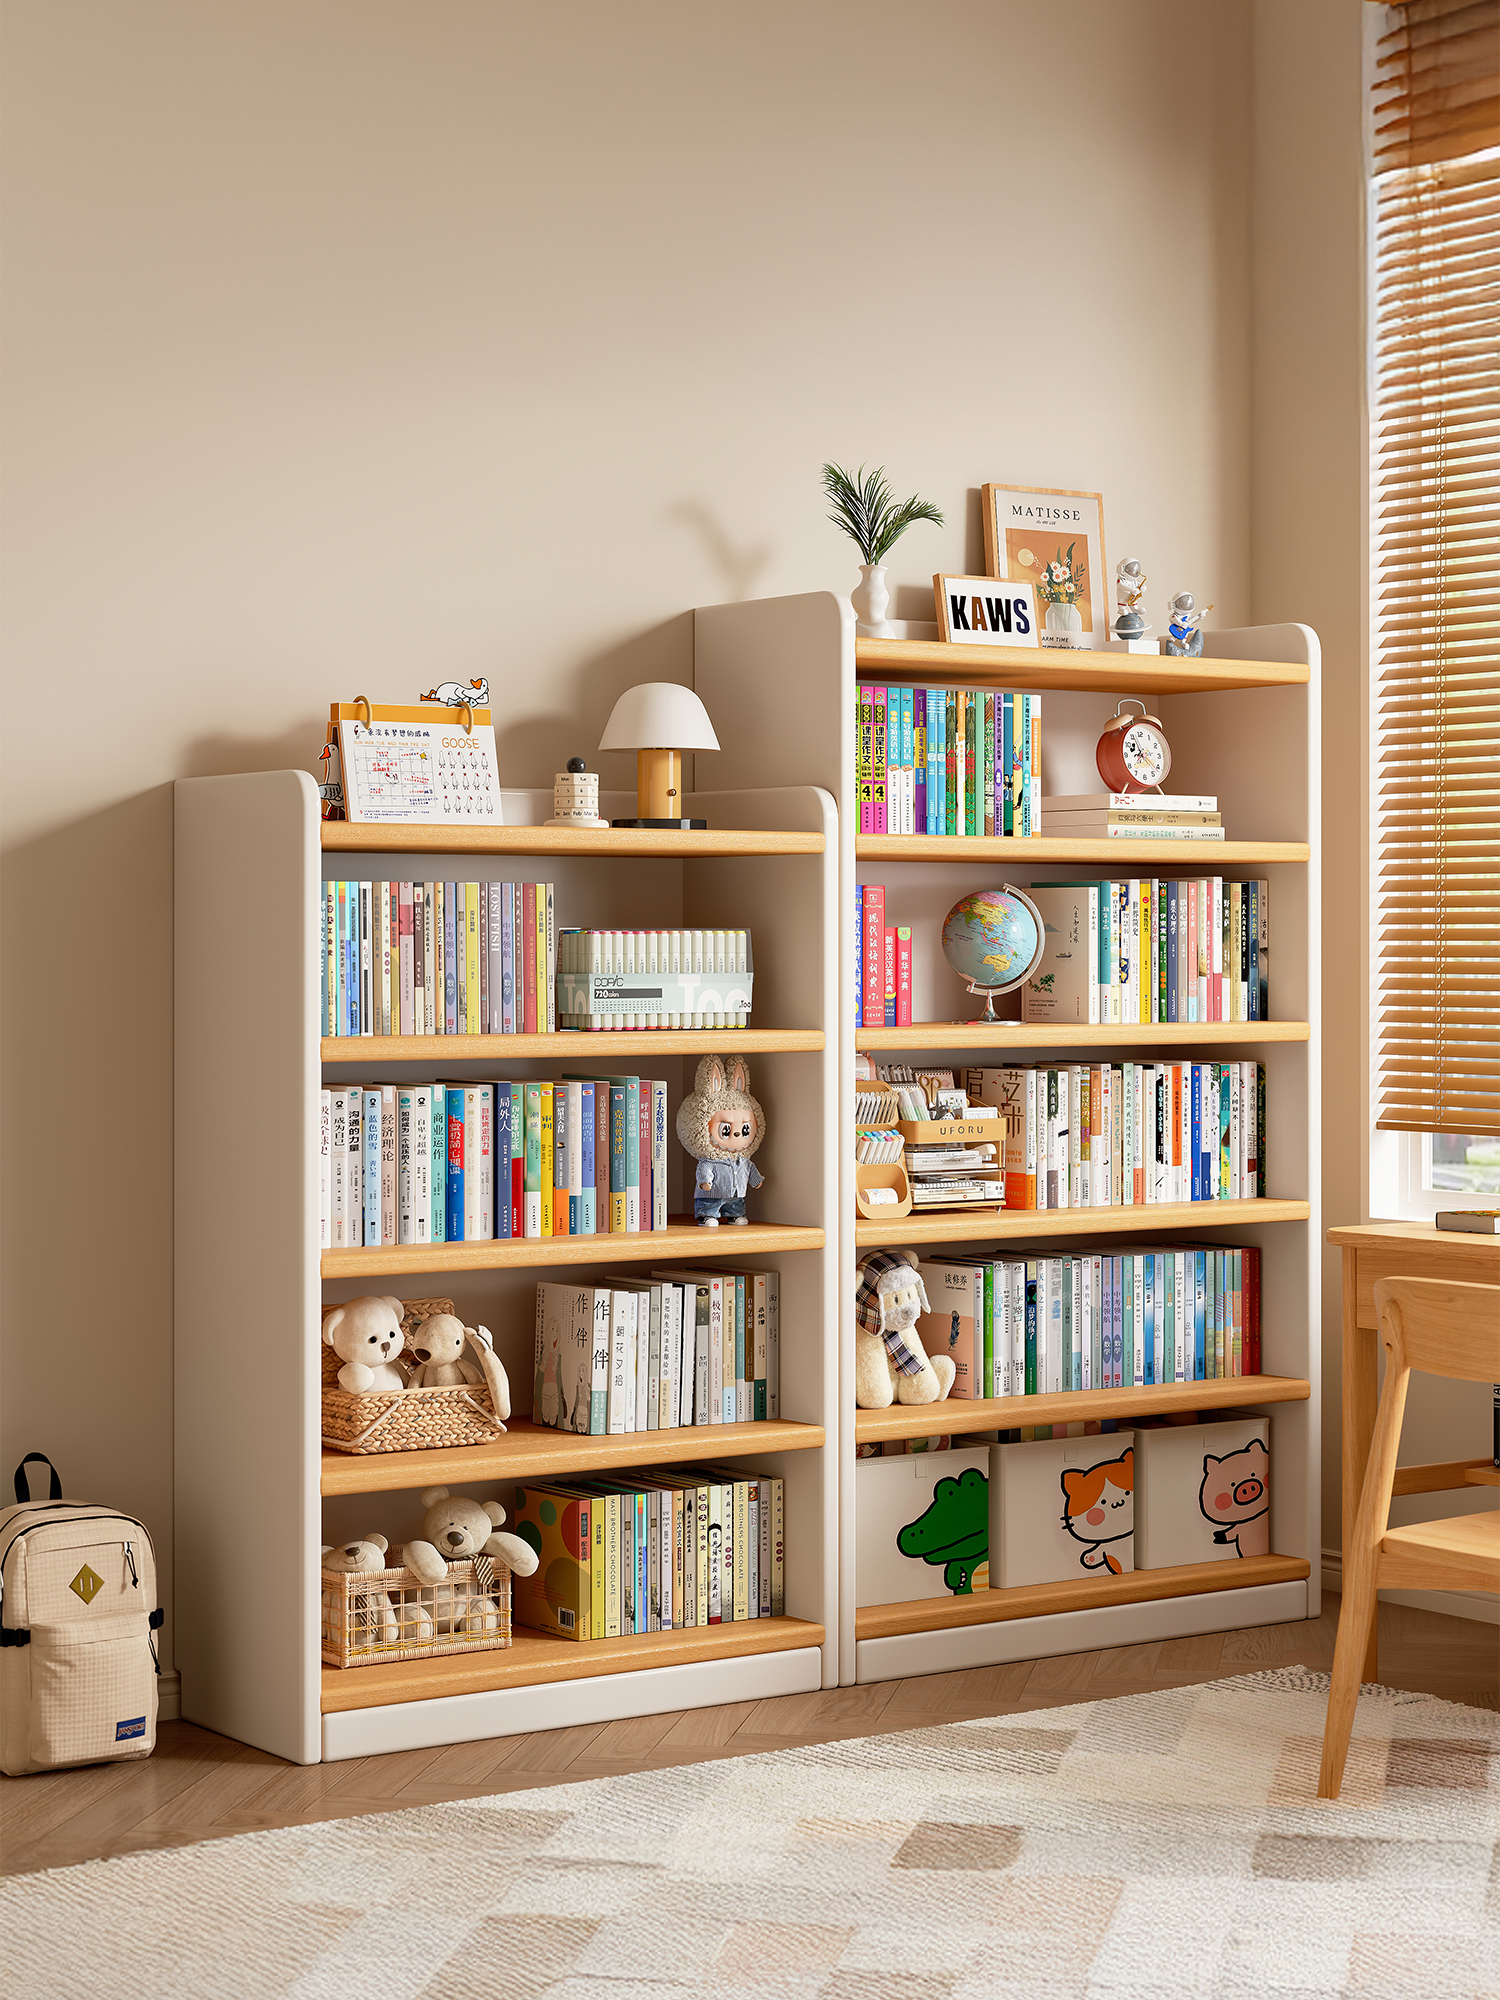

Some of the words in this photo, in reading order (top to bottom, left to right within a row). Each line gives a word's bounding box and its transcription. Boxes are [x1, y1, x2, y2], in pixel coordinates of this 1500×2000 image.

[1011, 504, 1080, 521] MATISSE
[950, 595, 1030, 634] KAWS
[441, 737, 480, 749] GOOSE
[862, 725, 871, 765] 课堂作文
[875, 725, 885, 765] 课堂作文
[862, 786, 870, 796] 4
[875, 786, 884, 797] 4
[491, 886, 499, 920] LOST
[491, 922, 499, 952] FISH
[1260, 919, 1267, 940] 活着
[868, 912, 879, 988] 现代汉语词典
[885, 936, 893, 994] 新英汉汉英词典
[900, 951, 909, 991] 新华字典
[333, 1117, 345, 1147] 成为自己
[349, 1110, 360, 1152] 沟通的力量
[368, 1114, 378, 1150] 蓝色的雪
[481, 1107, 490, 1155] 自我肯定的力量
[499, 1097, 512, 1132] 局外人
[640, 1101, 649, 1139] 呼啸山庄
[656, 1096, 664, 1142] 了不起的盖茨比
[940, 1125, 984, 1135] UFORU
[382, 1114, 394, 1162] 经济理论
[433, 1112, 443, 1160] 商业运作
[449, 1114, 461, 1175] 七堂极简心理课
[574, 1293, 588, 1348] 作伴
[711, 1300, 721, 1323] 极简
[768, 1294, 777, 1314] 面纱
[591, 1299, 610, 1370] 作伴
[615, 1325, 625, 1387] 朝花夕拾
